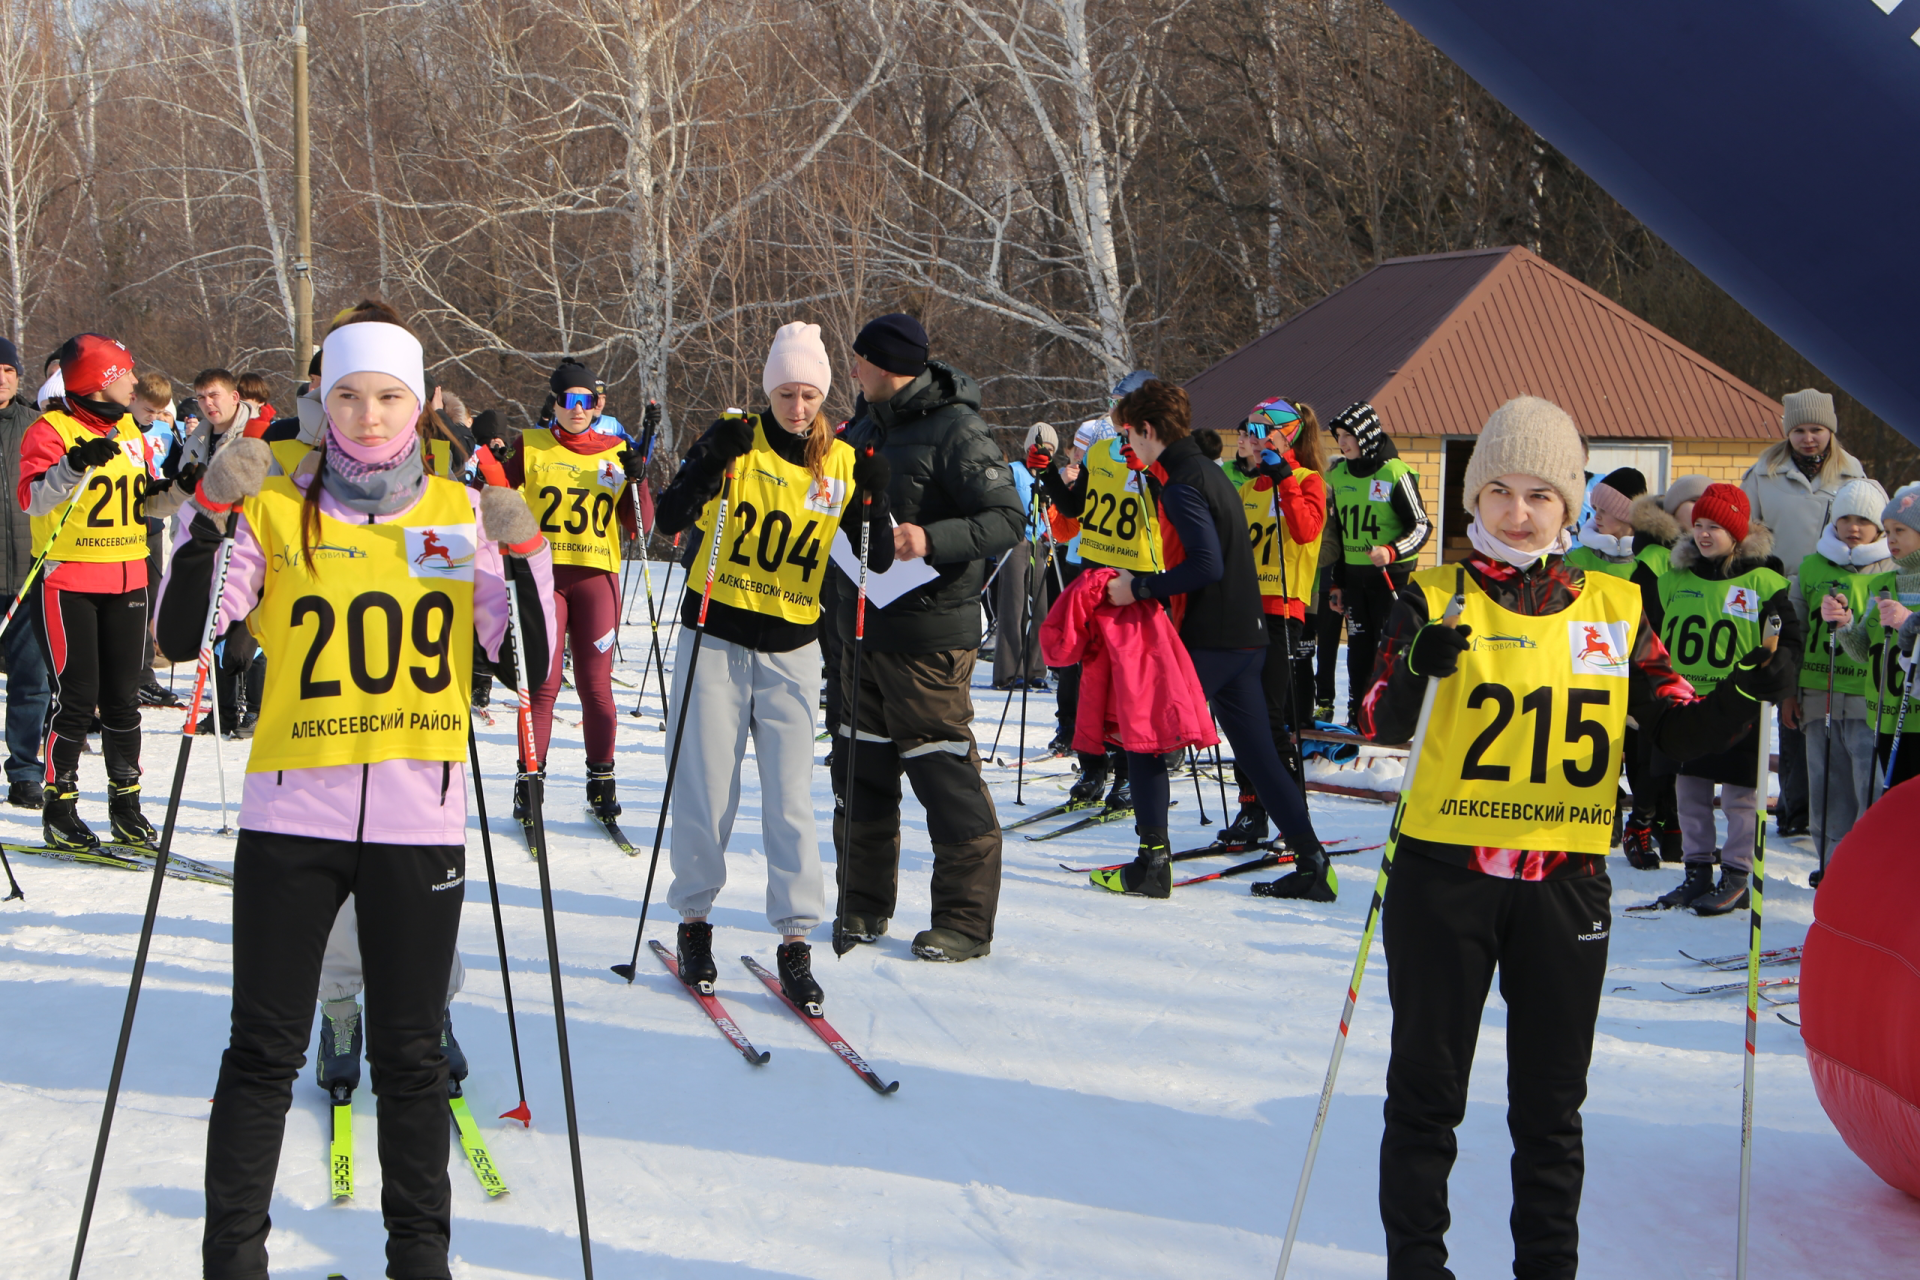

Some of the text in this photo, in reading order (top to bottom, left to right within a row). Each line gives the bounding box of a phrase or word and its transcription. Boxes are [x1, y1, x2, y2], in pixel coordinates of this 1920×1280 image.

[87, 473, 146, 528] 218
[539, 486, 614, 538] 230
[1082, 488, 1139, 541] 228
[728, 501, 821, 583] 204
[859, 525, 870, 585] BRADOS
[1116, 547, 1139, 559] РАЙОН
[290, 590, 454, 701] 209
[1664, 614, 1738, 669] 160
[185, 671, 202, 725] SPORT
[291, 708, 462, 739] АЛЕКСЕЕВСКИЙ РАЙОН
[1895, 684, 1911, 738] BRADOS
[525, 711, 537, 762] SPORT
[1461, 682, 1611, 788] 215
[1438, 798, 1565, 822] АЛЕКСЕЕВСКИЙ
[41, 851, 76, 862] FISCHER
[109, 845, 136, 855] FISCHER
[334, 1154, 350, 1191] FISCHER
[469, 1147, 501, 1187] FISCHER
